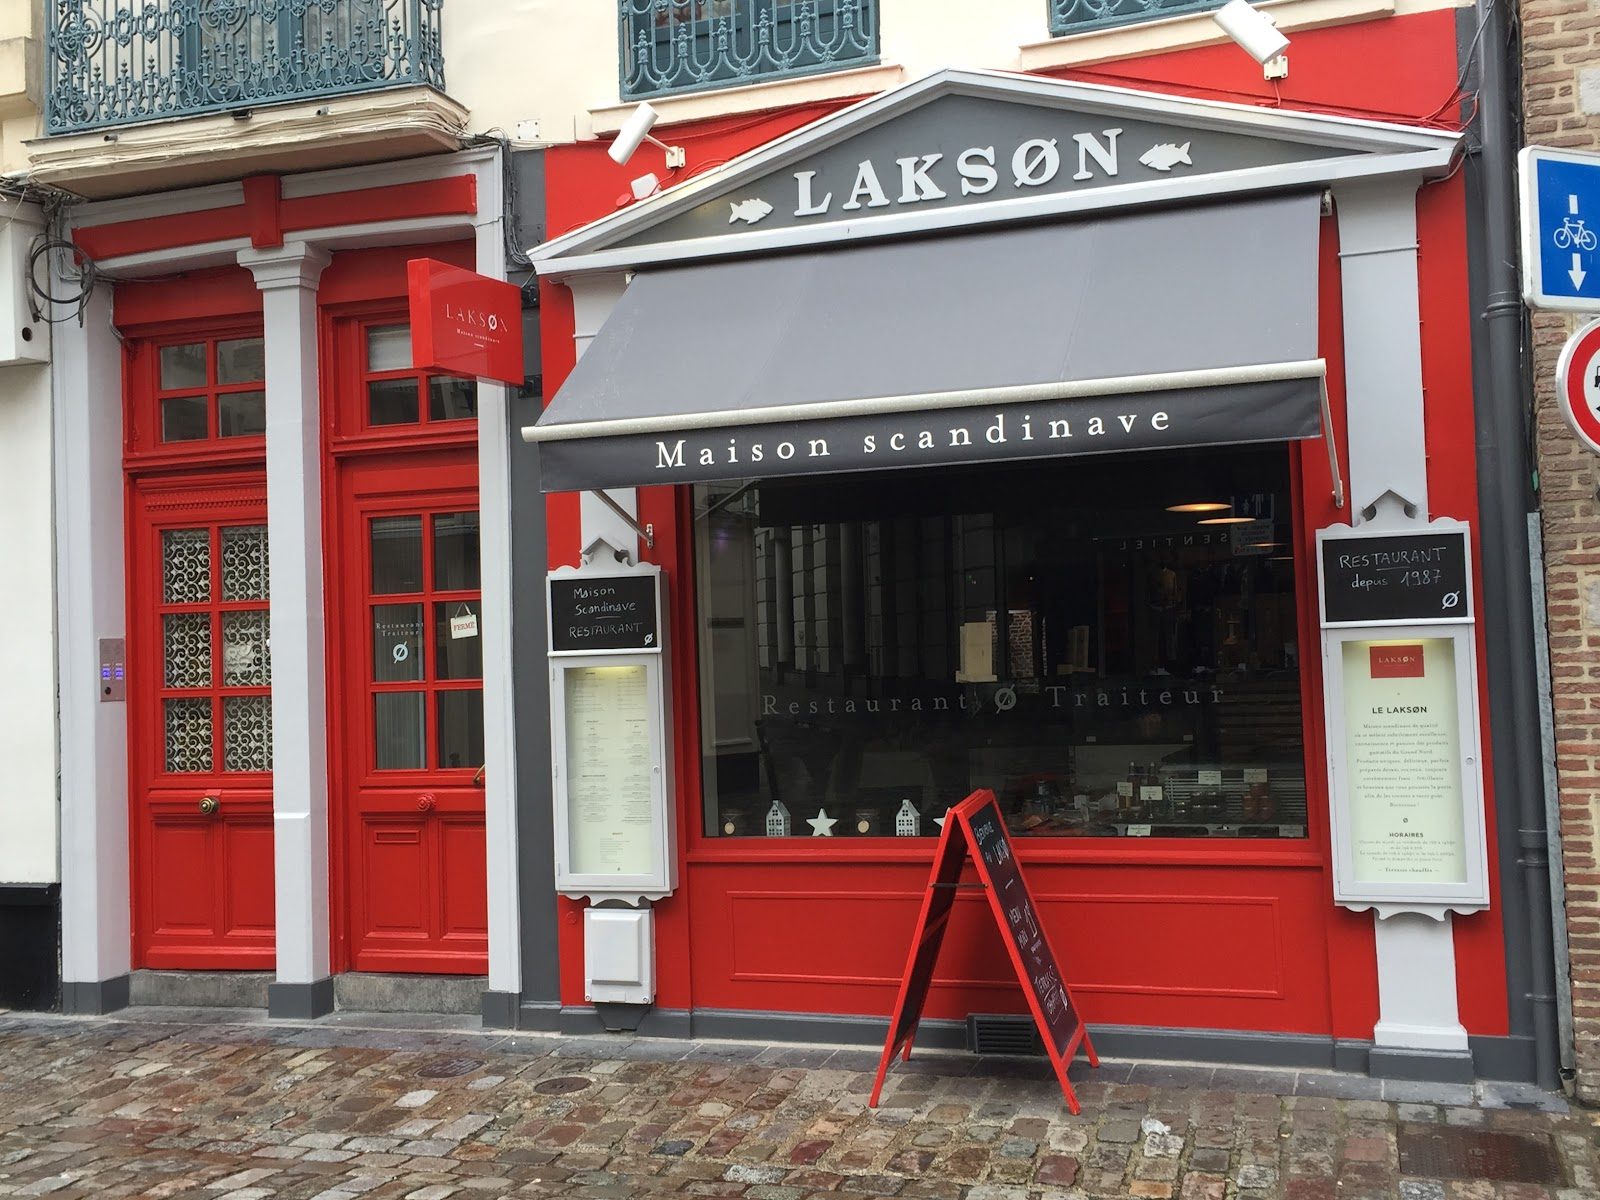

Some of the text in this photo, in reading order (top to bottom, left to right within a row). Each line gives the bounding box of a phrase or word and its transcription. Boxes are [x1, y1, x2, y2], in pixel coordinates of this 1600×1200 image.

[793, 128, 1123, 216] LAKSØN
[655, 411, 1170, 470] Maison scandinave
[1339, 546, 1447, 569] RESTAURANT
[1400, 569, 1442, 587] 1987
[573, 587, 616, 600] Maison
[574, 601, 637, 616] Scandinave
[569, 622, 643, 639] RESTAURANT
[1378, 656, 1416, 664] LAKSØN
[762, 694, 968, 715] Restaurant
[1045, 686, 1224, 708] Traiteur
[1387, 706, 1428, 714] LAKSØN
